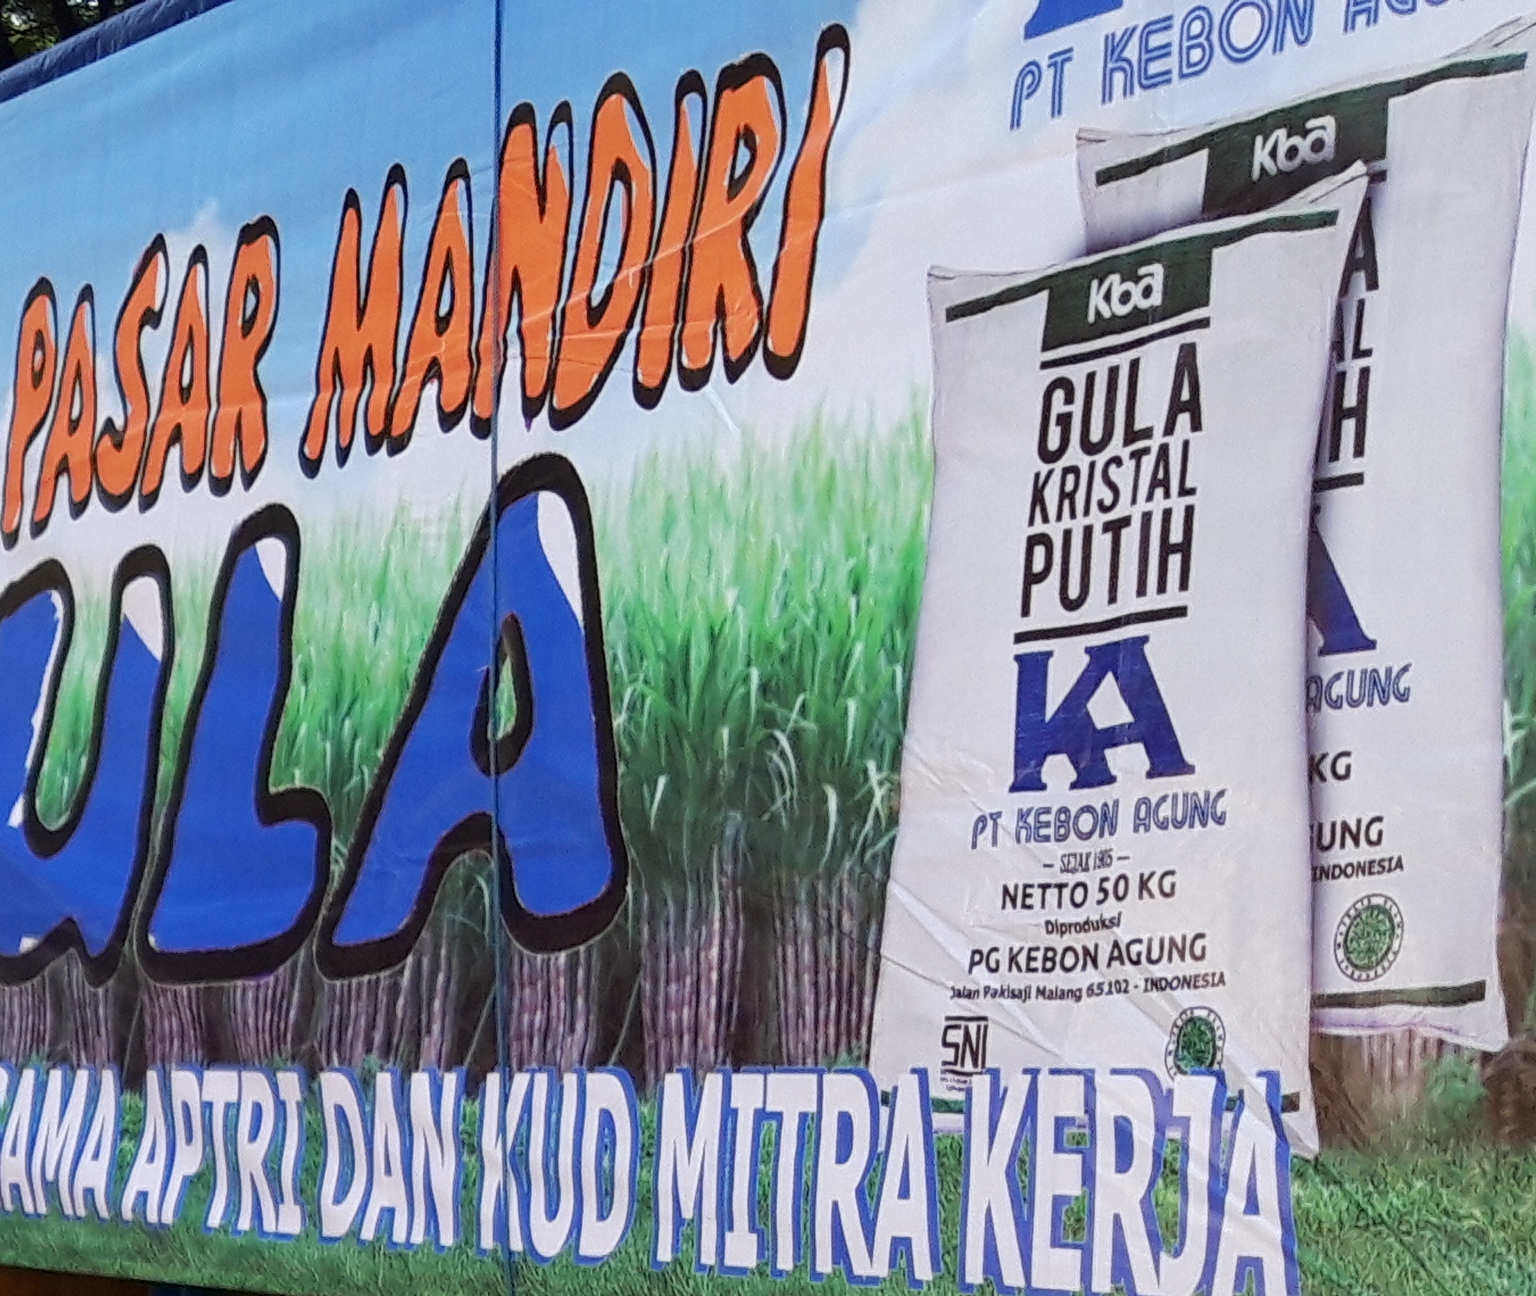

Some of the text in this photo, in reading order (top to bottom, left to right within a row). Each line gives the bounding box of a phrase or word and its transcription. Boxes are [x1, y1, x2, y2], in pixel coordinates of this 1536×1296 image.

[1010, 0, 1315, 131] PT KEBON
[1251, 115, 1337, 183] Kba
[1, 215, 281, 550] PASAR
[299, 23, 851, 480] MANDIRI
[1086, 262, 1165, 325] Kba
[1037, 342, 1203, 464] GULA
[1027, 438, 1198, 527] KRISTAL
[1020, 503, 1197, 618] PUTIH
[1305, 664, 1413, 713] AGUNG
[1308, 751, 1352, 785] KG
[971, 788, 1227, 850] PT KEBON AGUNG
[1001, 870, 1177, 911] NETTO 50 KG
[1311, 855, 1405, 883] INDONESIA
[968, 932, 1207, 975] PG KEBON AGUNG
[1035, 986, 1083, 1003] Malang
[1143, 971, 1227, 994] INDONESIA
[120, 1063, 306, 1239] APTRI
[319, 1066, 467, 1250] DAN
[478, 1066, 640, 1264] KUD
[653, 1066, 940, 1289] MITRA
